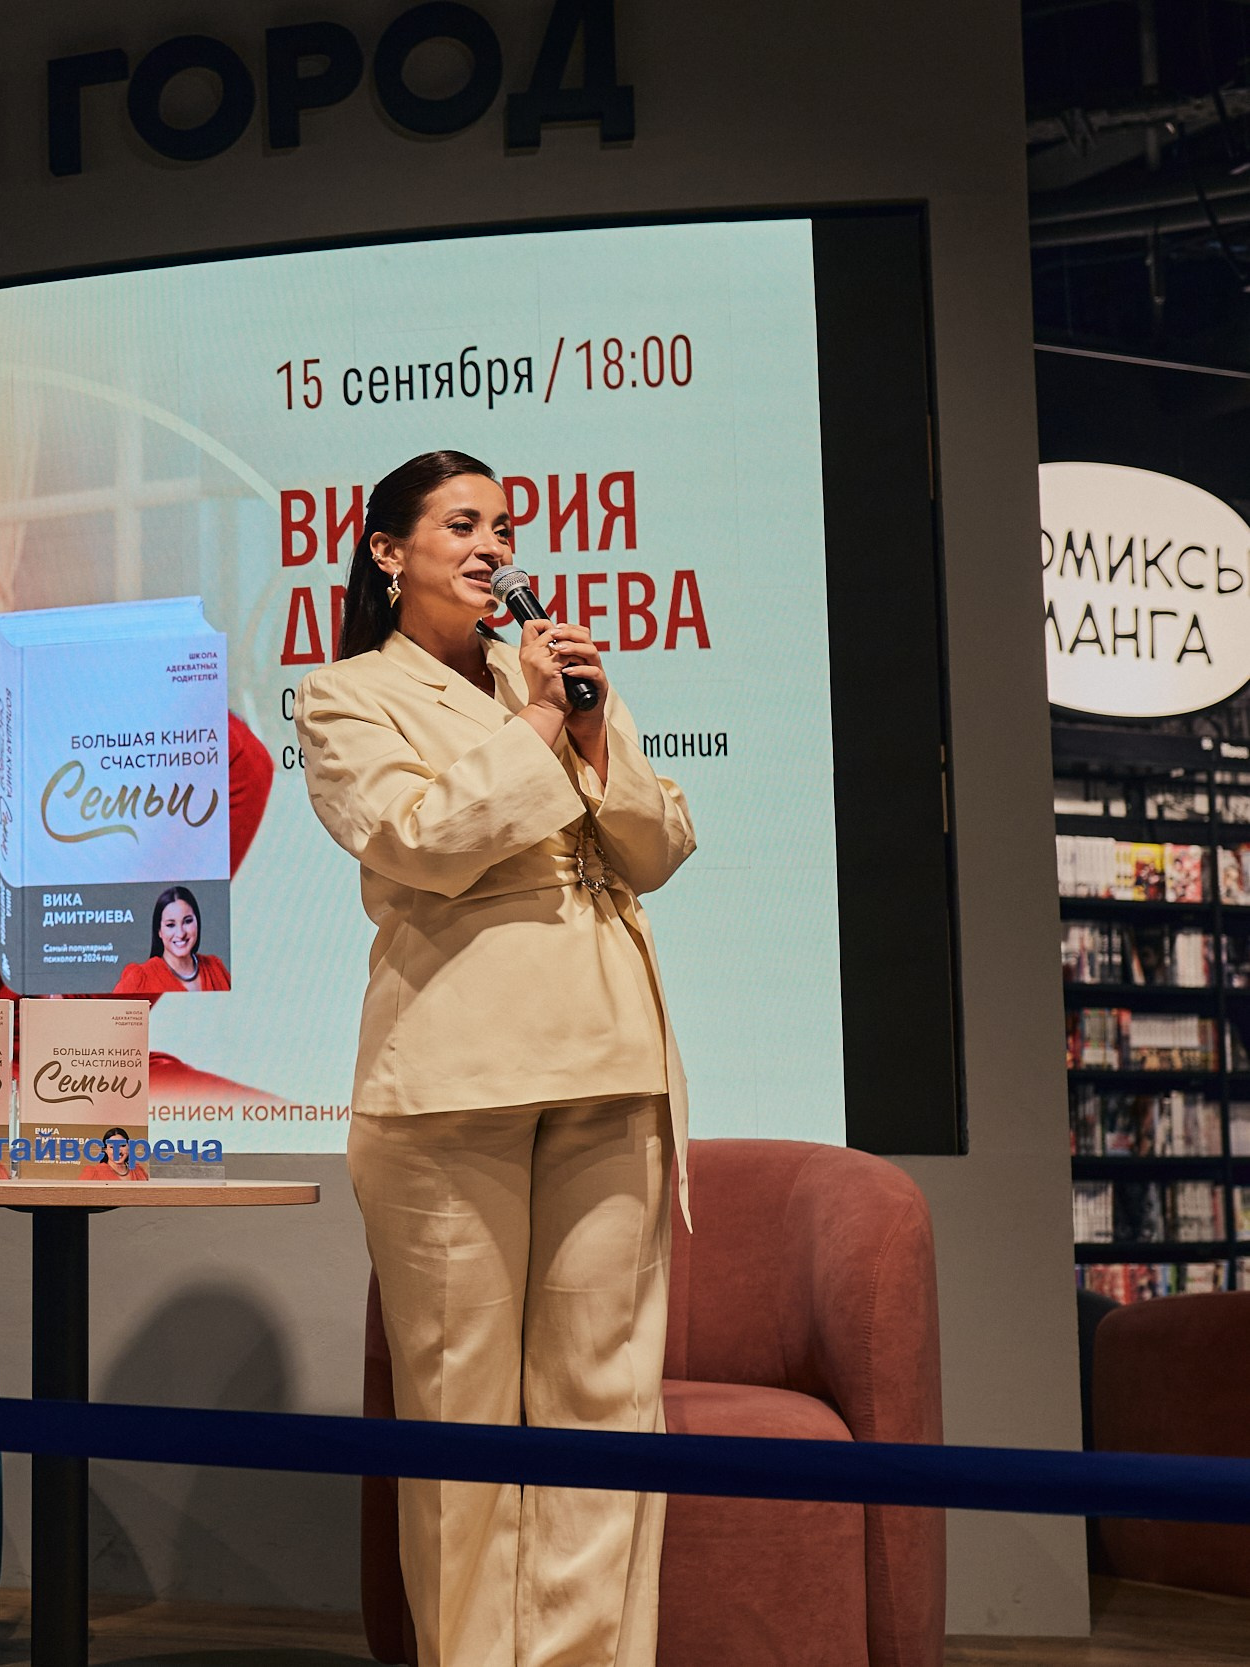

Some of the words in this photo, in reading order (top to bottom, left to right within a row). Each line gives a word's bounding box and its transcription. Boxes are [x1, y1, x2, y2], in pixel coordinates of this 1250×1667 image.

[46, 0, 636, 177] ГОРОД
[276, 358, 323, 410] 15
[342, 345, 534, 410] сентября
[575, 334, 693, 391] 18:00
[280, 470, 638, 568] ВИРИЯ
[189, 651, 218, 660] ШКОЛА
[165, 662, 218, 673] АДЕКВАТНЫХ
[171, 672, 219, 683] РОДИТЕЛЕЙ
[70, 731, 156, 750] БОЛЬШАЯ
[161, 728, 219, 746] КНИГА
[643, 732, 728, 758] мания
[100, 746, 219, 771] СЧАСТЛИВОЙ
[40, 759, 219, 846] Семьи
[42, 892, 84, 908] ВИКА
[42, 909, 135, 927] ДМИТРИЕВА
[43, 943, 68, 953] Самый
[68, 942, 114, 954] популярный
[42, 954, 77, 964] психолог
[82, 952, 101, 963] 2024
[101, 954, 120, 964] году
[53, 1047, 105, 1056] БОЛЬШАЯ
[107, 1048, 143, 1057] КНИГА
[70, 1058, 143, 1068] СЧАСТЛИВОЙ
[33, 1060, 143, 1106] Семьи
[242, 1104, 350, 1122] компани
